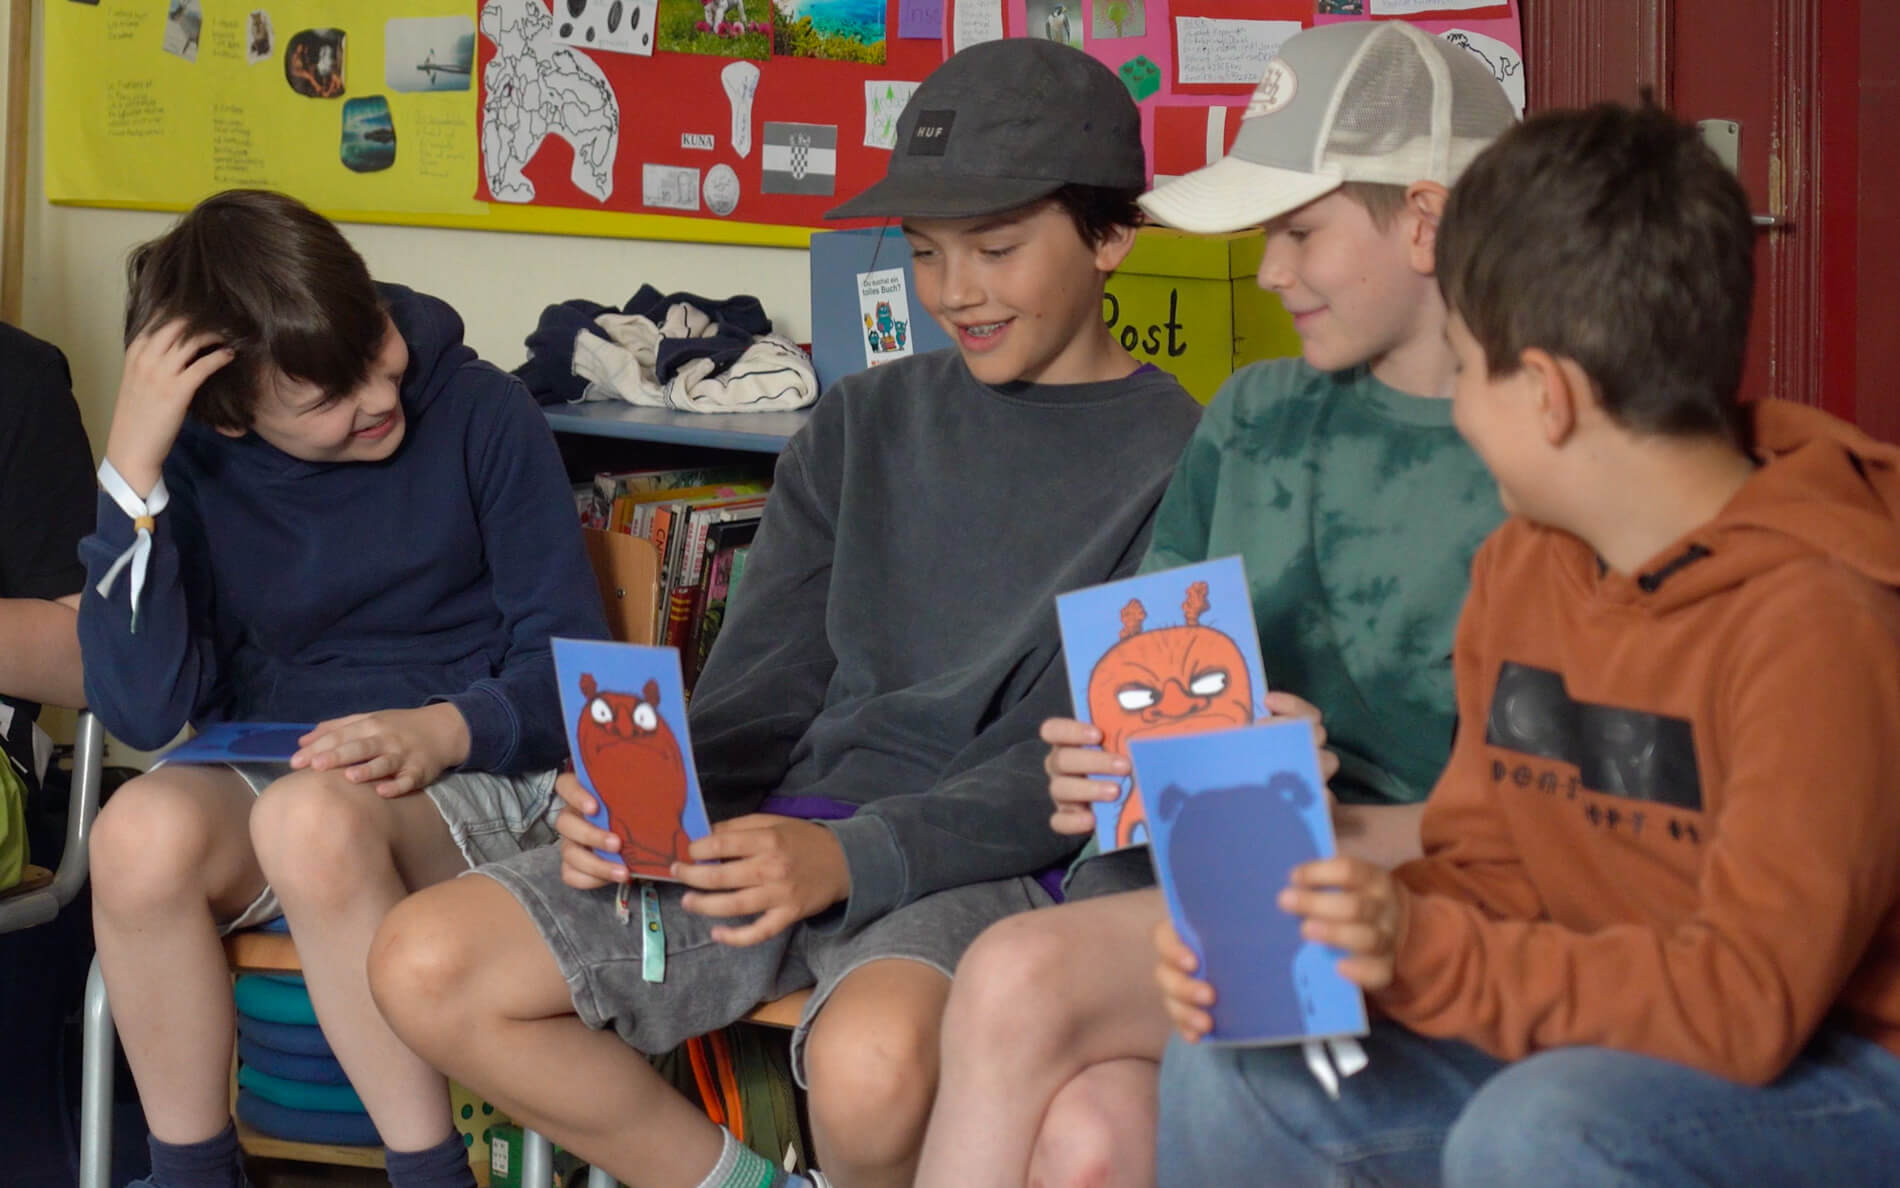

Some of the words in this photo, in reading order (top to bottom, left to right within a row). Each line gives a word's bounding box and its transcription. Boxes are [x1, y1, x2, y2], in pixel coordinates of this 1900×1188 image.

[916, 126, 944, 138] HUF
[683, 133, 713, 147] KUNA
[881, 283, 901, 294] Buch?
